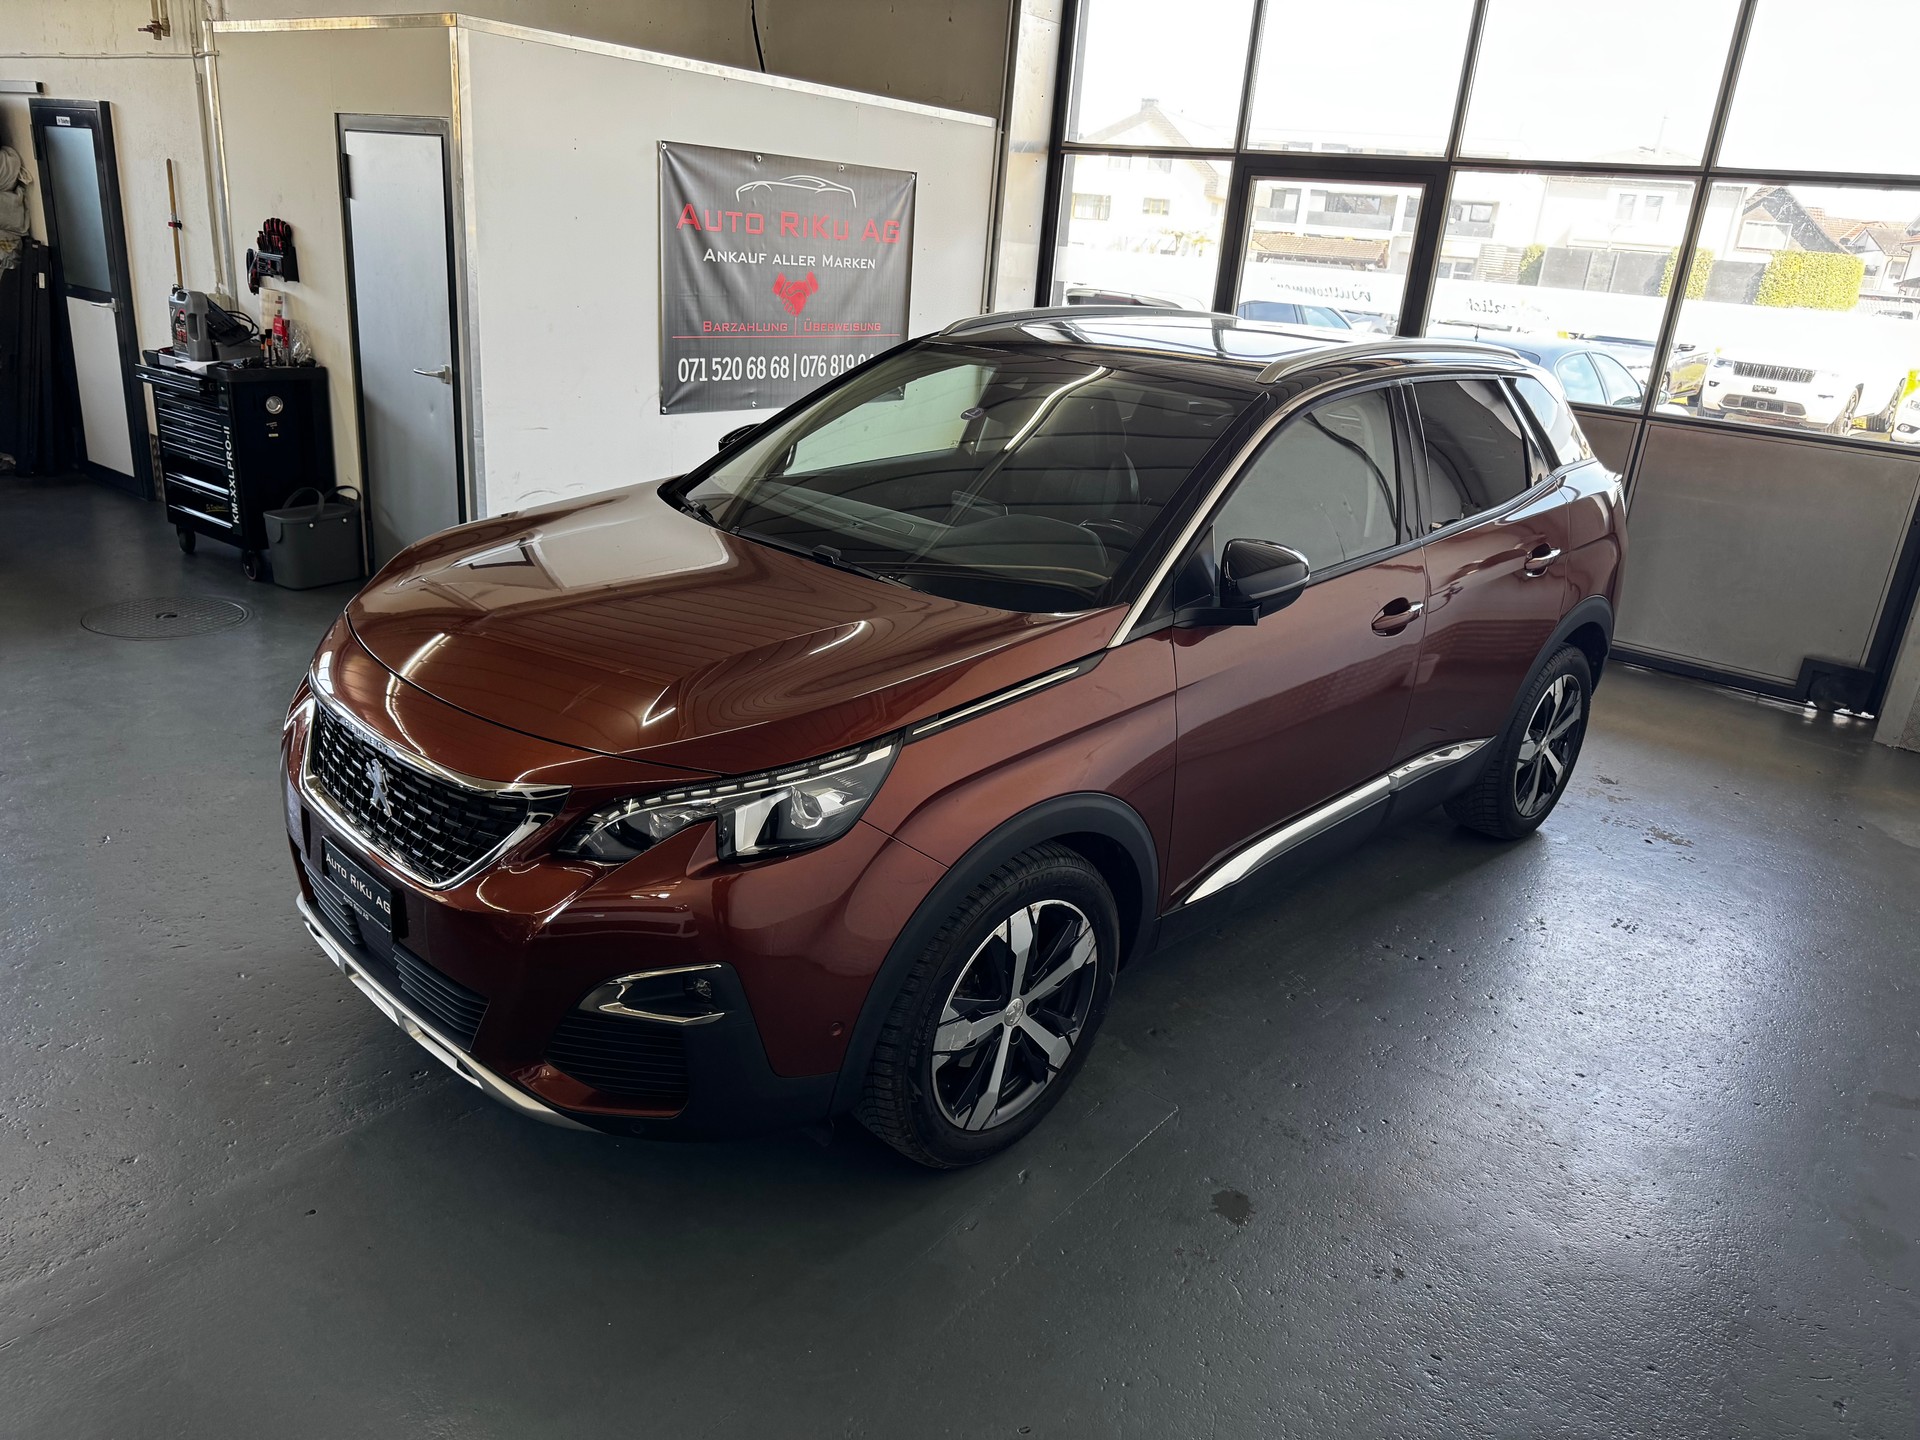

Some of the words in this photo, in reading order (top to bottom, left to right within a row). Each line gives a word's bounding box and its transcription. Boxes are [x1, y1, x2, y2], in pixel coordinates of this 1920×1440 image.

[676, 203, 764, 235] AUTO
[861, 219, 900, 243] AG
[703, 248, 767, 264] ANKAUF
[772, 254, 816, 267] ALLER
[822, 254, 876, 269] MARKEN
[703, 321, 788, 333] BARZAHLUNG
[804, 318, 881, 332] ÜBERWEISUNG
[678, 358, 708, 383] 071
[712, 357, 743, 381] 520
[746, 356, 767, 380] 68
[770, 355, 790, 379] 68
[800, 355, 827, 378] 076
[830, 354, 855, 376] 819
[223, 426, 240, 524] KM-XXLPRO-II
[344, 719, 390, 754] PEUGEOT
[326, 853, 347, 879] AUTO
[350, 874, 372, 900] RIKU
[376, 896, 391, 915] AG
